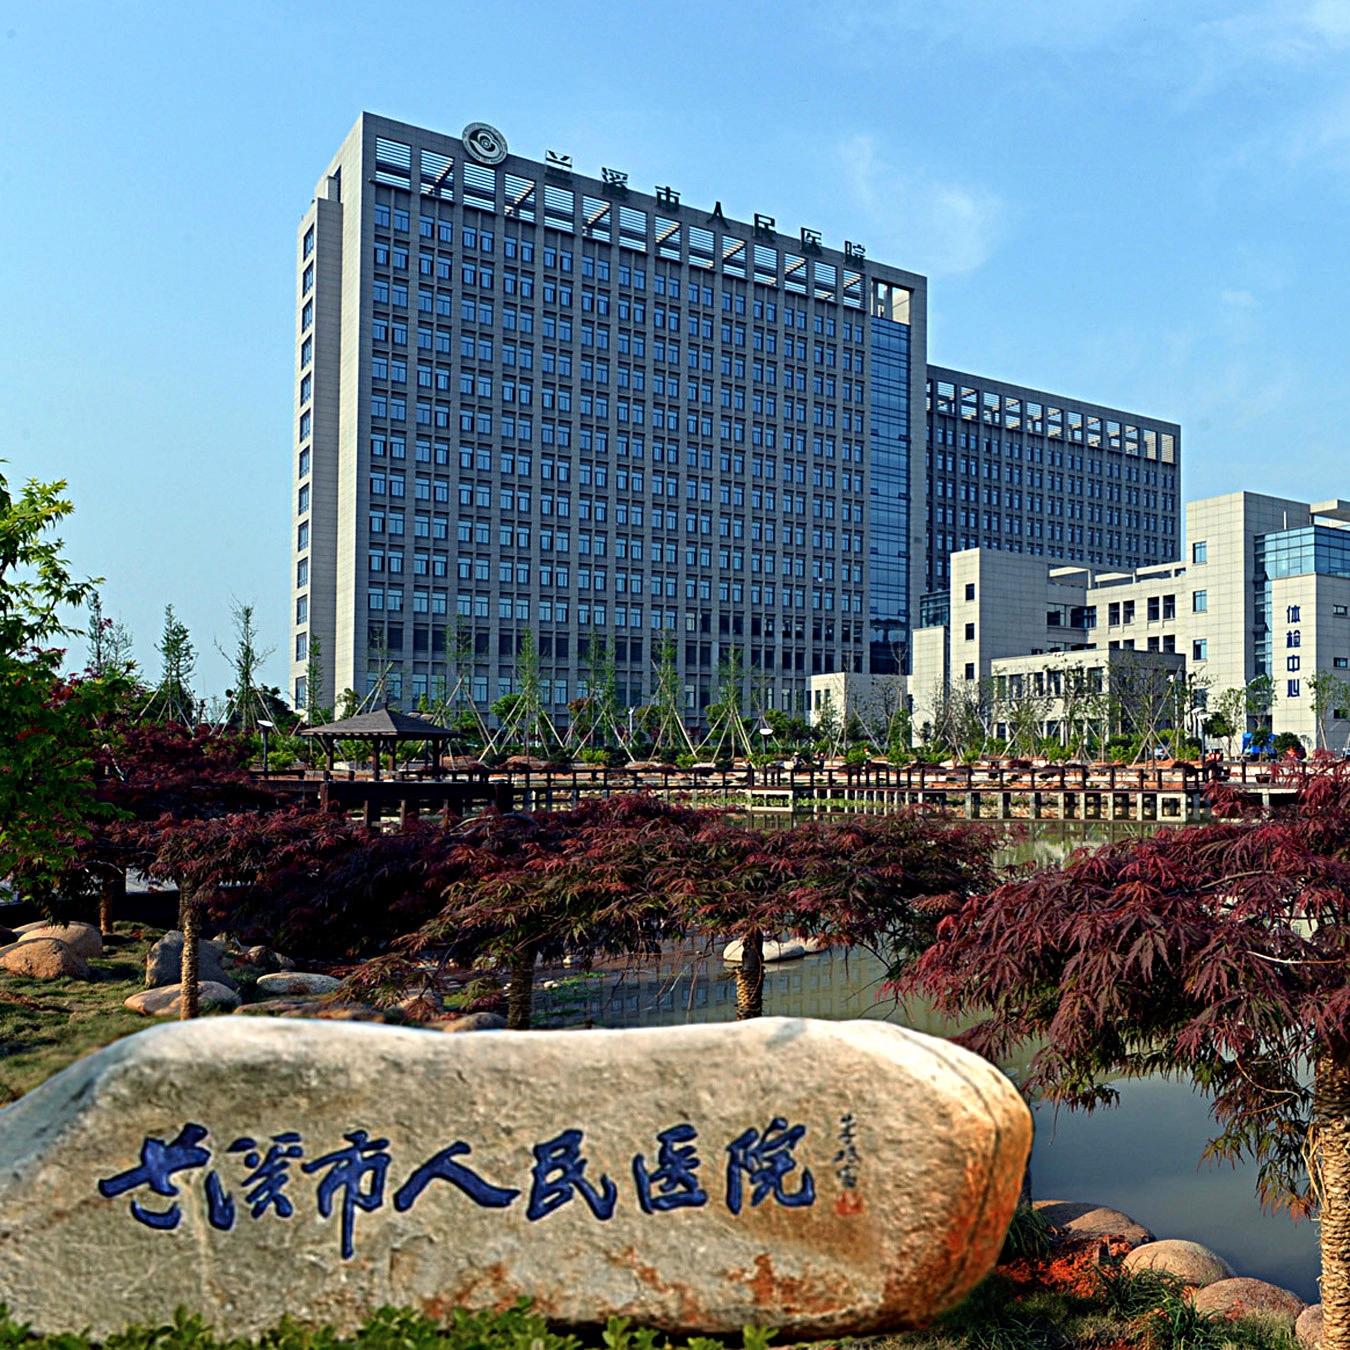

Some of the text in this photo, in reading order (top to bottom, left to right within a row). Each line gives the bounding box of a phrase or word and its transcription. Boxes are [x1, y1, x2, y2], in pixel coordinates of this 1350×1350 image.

[545, 149, 866, 269] 兰溪市人民医院
[1286, 604, 1301, 698] 体检中心
[98, 1118, 816, 1258] 兰溪市人民医院
